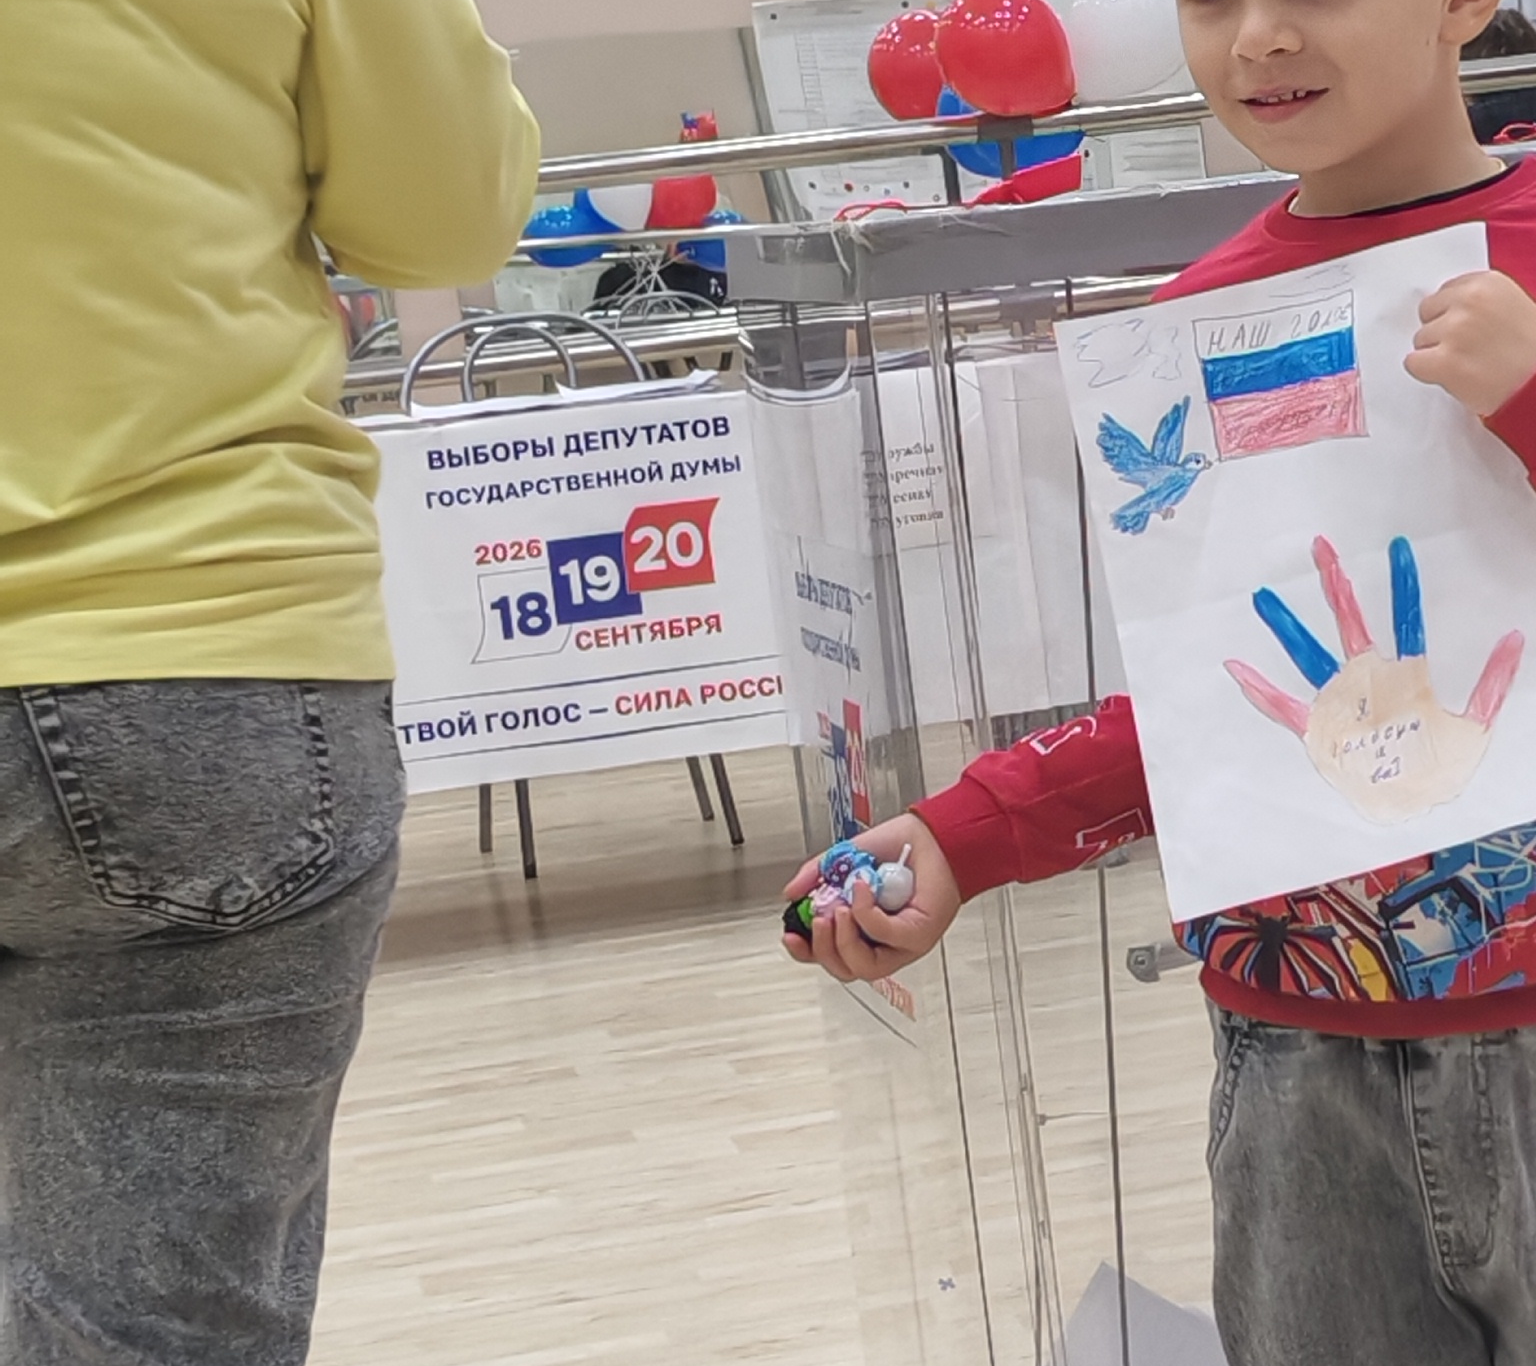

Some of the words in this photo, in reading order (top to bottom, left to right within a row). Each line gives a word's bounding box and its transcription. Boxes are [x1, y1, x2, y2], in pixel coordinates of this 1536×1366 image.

[427, 436, 555, 471] ВЫБОРЫ
[563, 415, 731, 458] ДЕПУТАТОВ
[425, 461, 664, 510] ГОСУДАРСТВЕННОЙ
[669, 454, 742, 485] ДУМЫ
[473, 538, 544, 567] 2026
[489, 591, 553, 641] 18
[558, 554, 622, 606] 19
[629, 520, 703, 574] 20
[574, 613, 723, 653] СЕНТЯБРЯ
[397, 709, 478, 745] ТВОЙ
[485, 701, 582, 735] ГОЛОС
[614, 686, 693, 717] СИЛА
